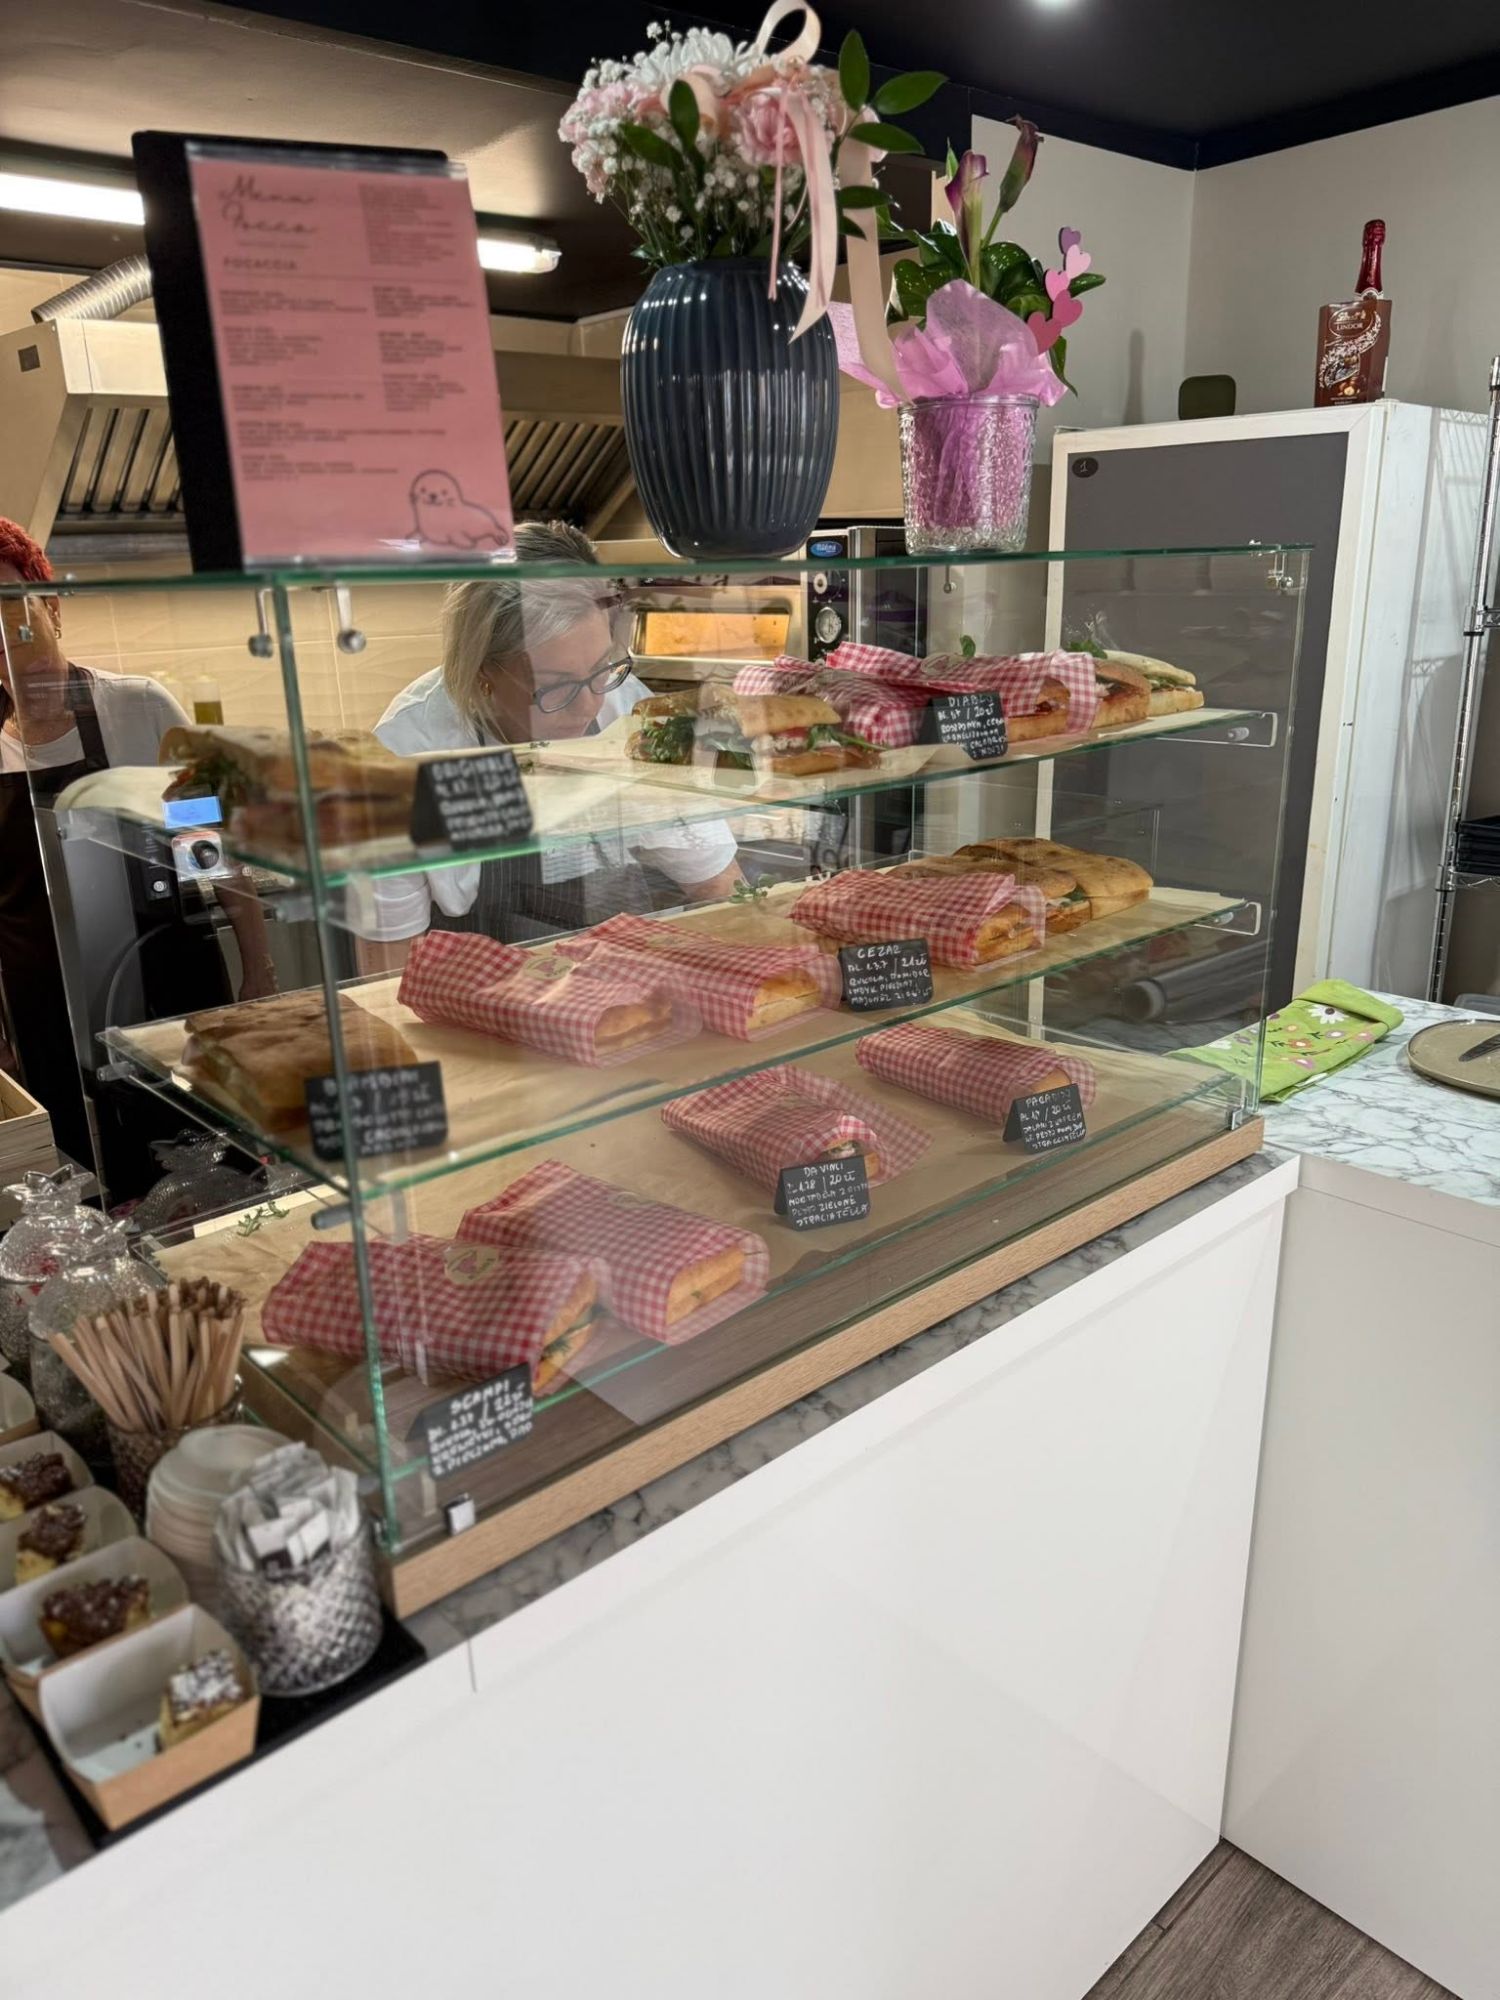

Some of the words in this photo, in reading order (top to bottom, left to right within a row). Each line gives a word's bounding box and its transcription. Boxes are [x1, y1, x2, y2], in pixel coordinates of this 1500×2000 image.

[1335, 322, 1364, 331] LINDOR
[857, 944, 902, 959] CEZAR
[803, 1166, 818, 1178] DA
[820, 1162, 844, 1174] VINCI
[818, 1193, 857, 1212] ZIELONE
